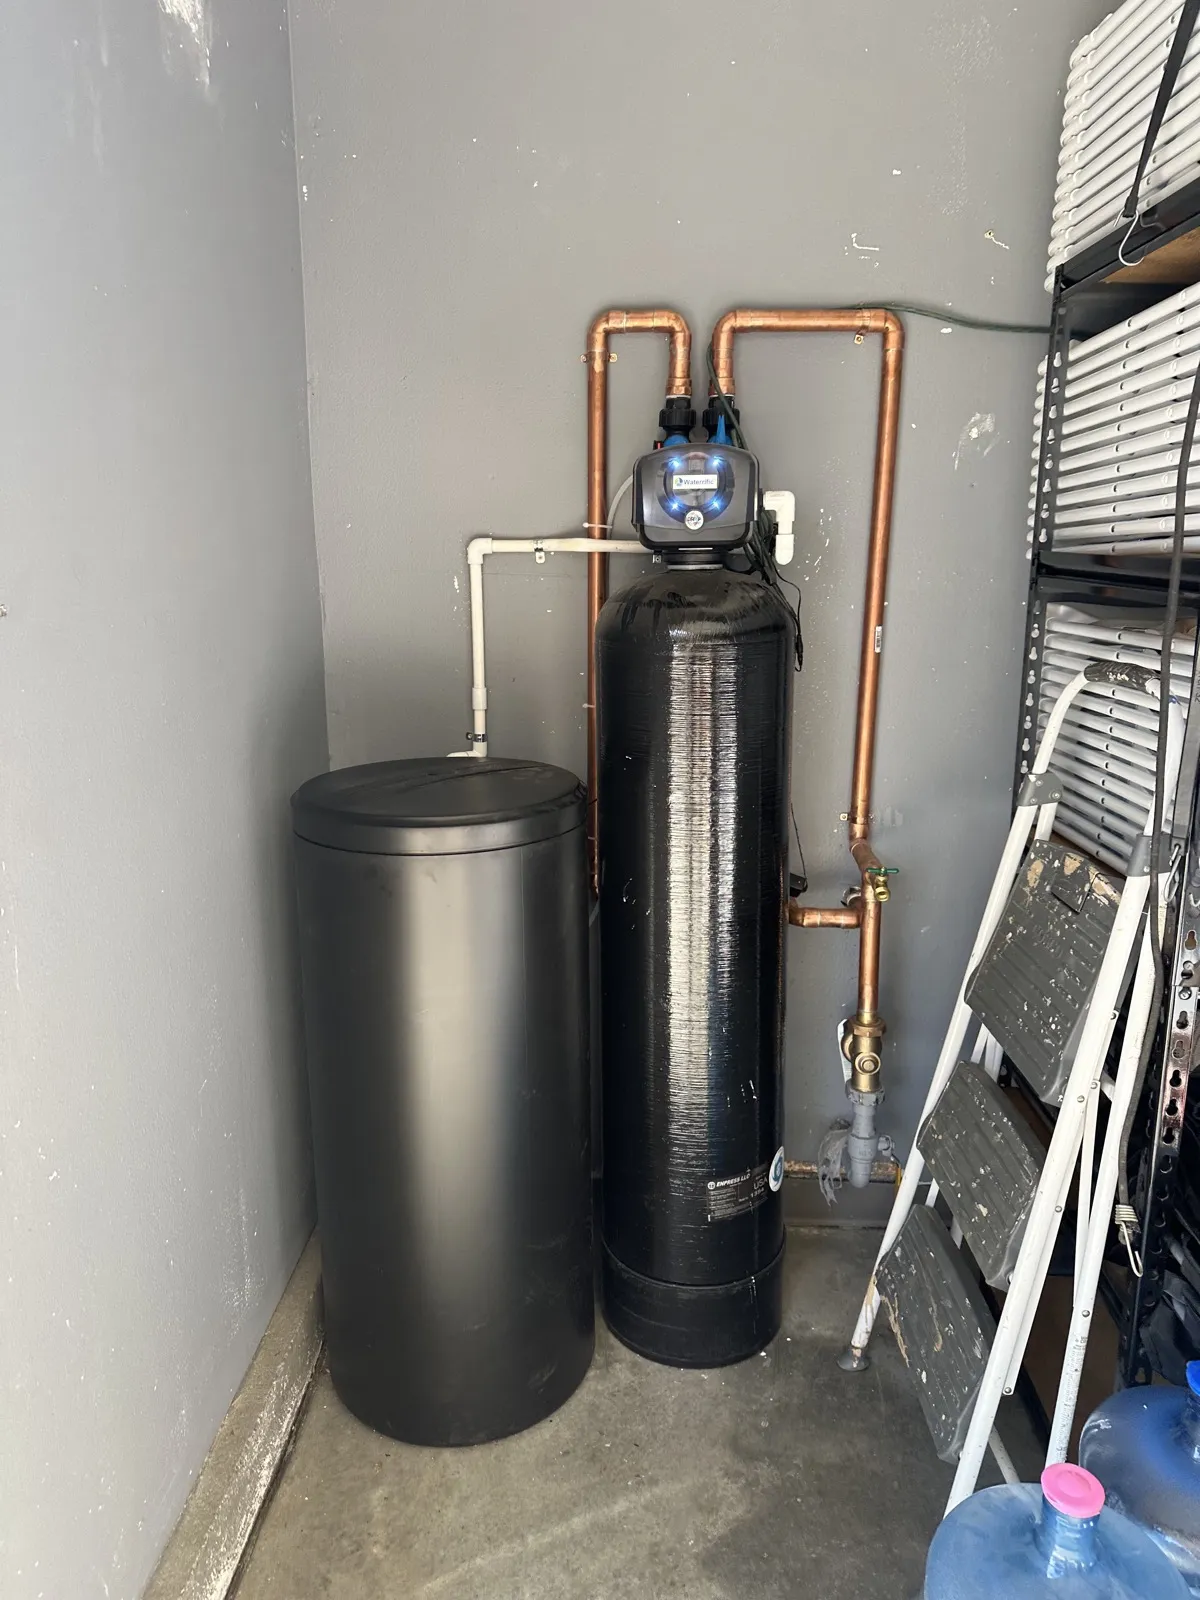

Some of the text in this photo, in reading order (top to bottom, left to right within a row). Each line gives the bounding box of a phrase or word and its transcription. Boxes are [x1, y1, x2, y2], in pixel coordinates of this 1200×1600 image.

[716, 1177, 740, 1187] ENPRESS
[741, 1173, 751, 1182] LLC
[753, 1177, 768, 1190] USA
